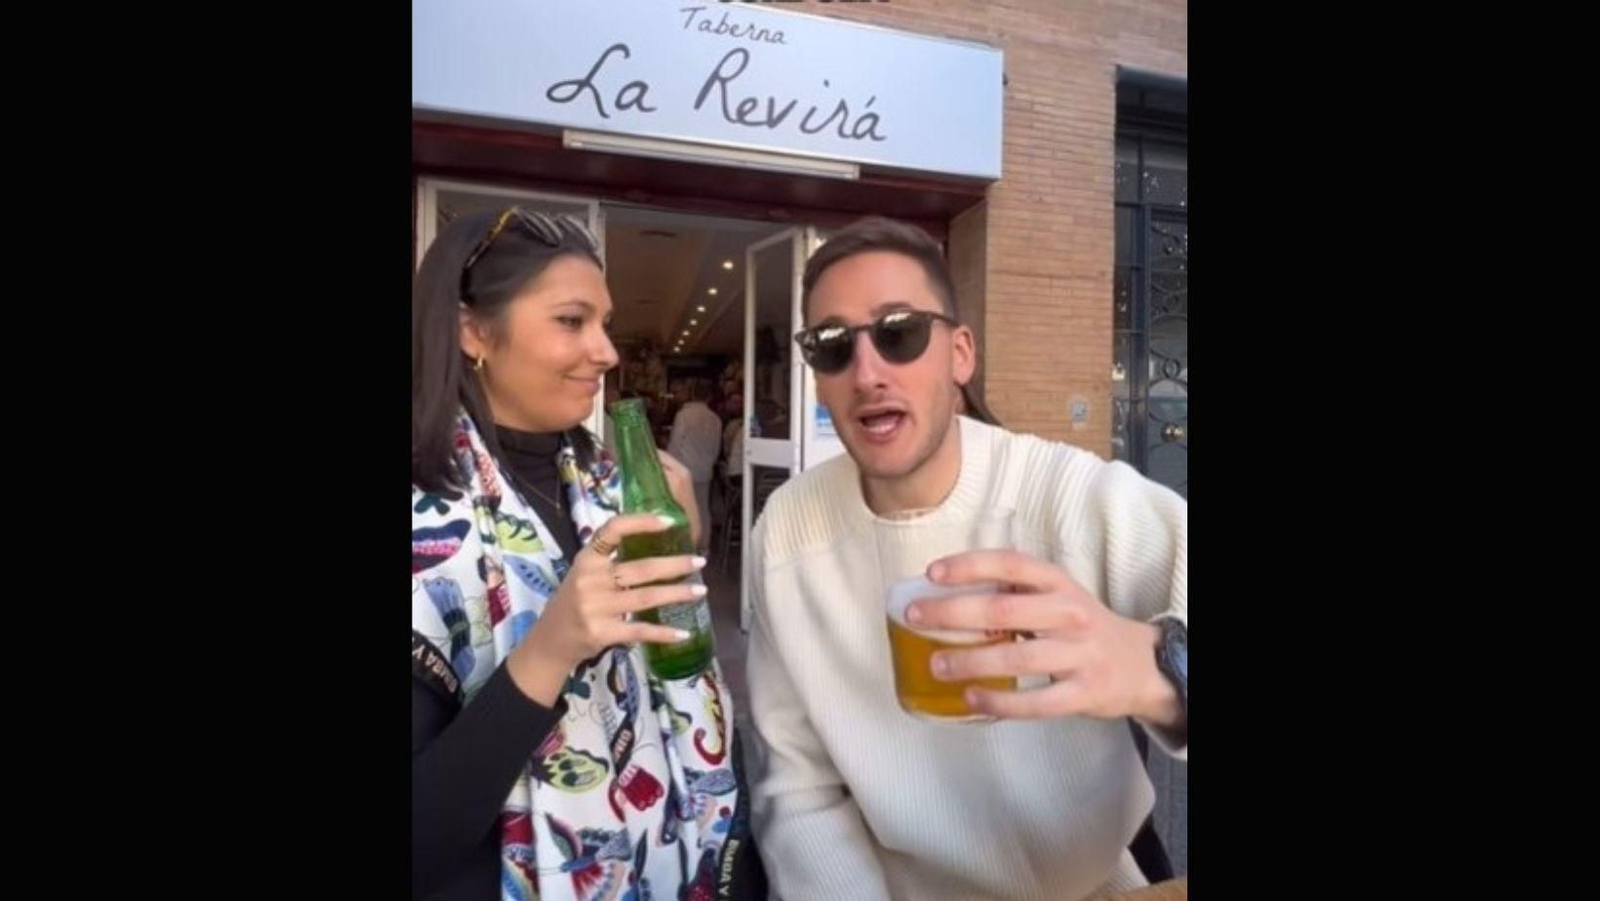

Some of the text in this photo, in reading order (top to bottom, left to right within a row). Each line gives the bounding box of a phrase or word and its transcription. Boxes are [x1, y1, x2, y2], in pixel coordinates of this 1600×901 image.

[680, 6, 787, 45] Taberna
[546, 43, 886, 141] La Revirá
